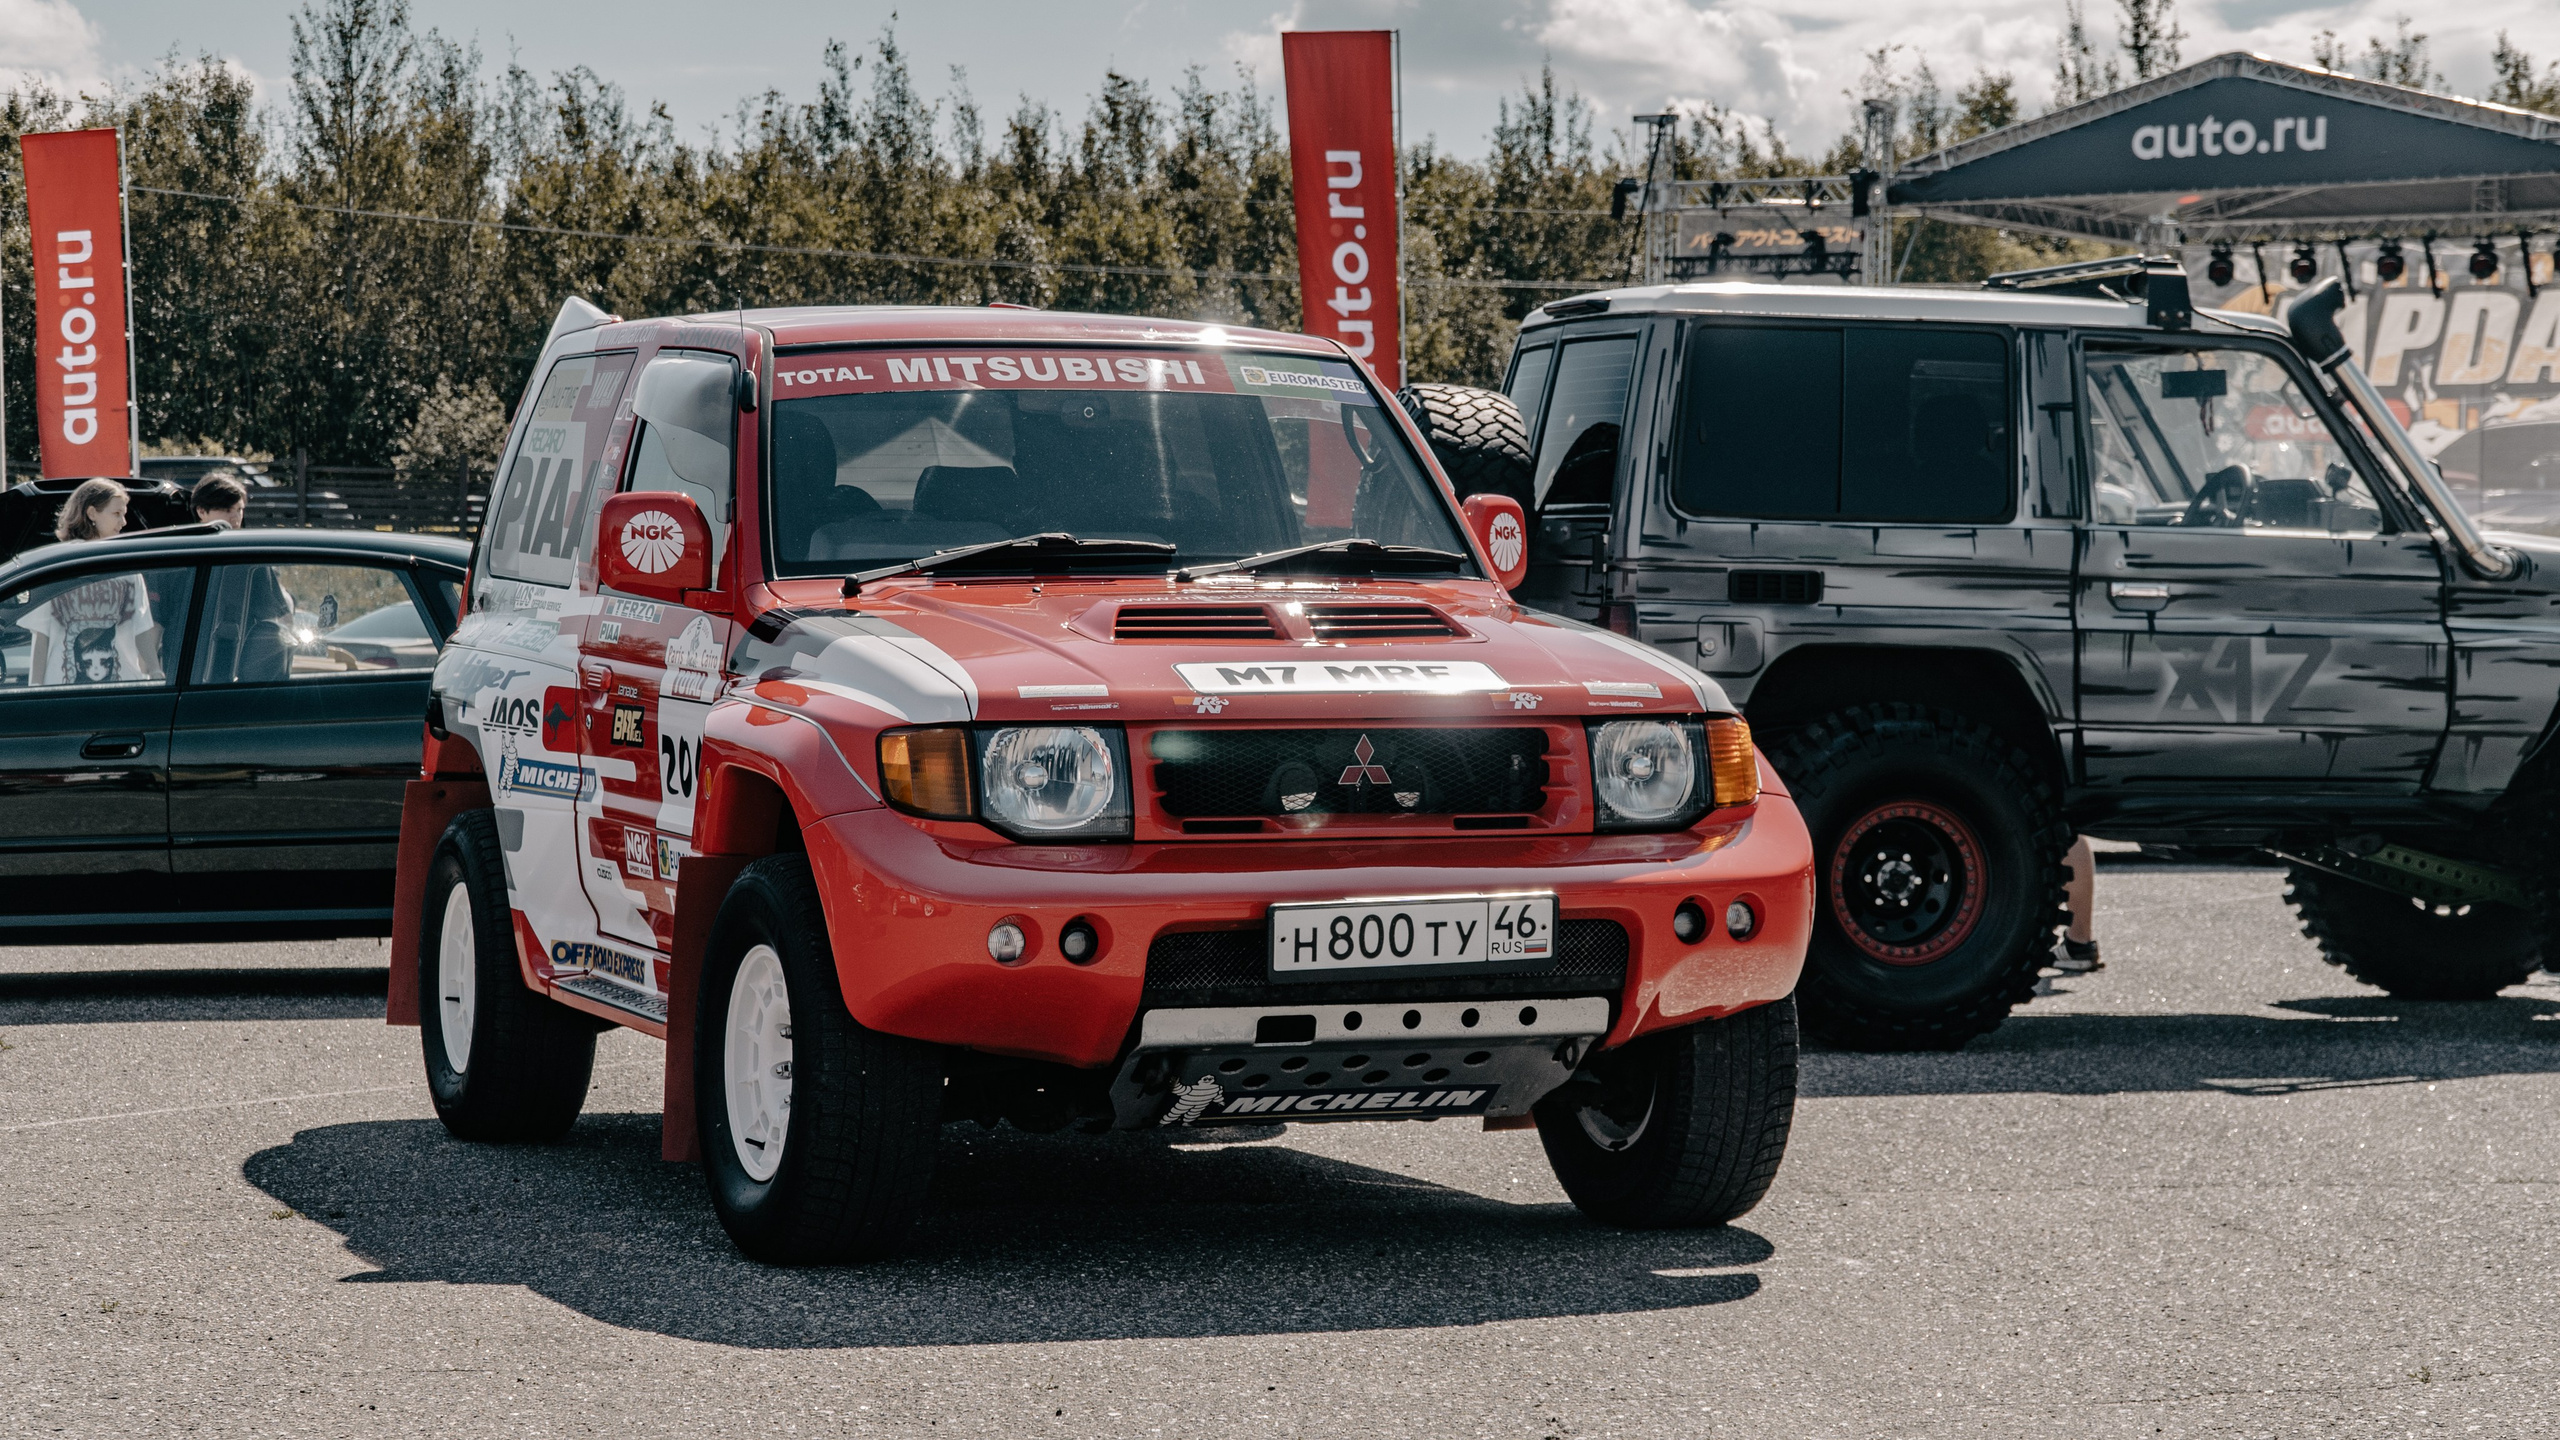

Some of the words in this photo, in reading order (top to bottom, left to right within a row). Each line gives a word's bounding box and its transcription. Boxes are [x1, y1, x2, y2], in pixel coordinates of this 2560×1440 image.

[2131, 115, 2328, 160] auto.ru
[1325, 149, 1376, 373] uto.ru
[56, 230, 98, 445] auto.ru
[777, 366, 874, 386] TOTAL
[885, 356, 1206, 385] MITSUBISHI
[1268, 372, 1364, 391] EUROMASTER
[528, 428, 567, 454] RECARO
[631, 525, 674, 541] NGK
[1494, 526, 1517, 541] NGK
[615, 599, 656, 621] TERZO
[599, 623, 620, 642] PIAA
[1215, 666, 1297, 686] M7
[1192, 696, 1230, 714] K&N
[1509, 693, 1543, 709] K&N
[483, 696, 540, 737] JAOS
[518, 765, 595, 793] MICHELIN
[626, 831, 650, 865] NGK
[1494, 904, 1537, 940] 46
[1491, 940, 1522, 954] RUS
[614, 953, 646, 985] EXPRESS
[1220, 1089, 1488, 1114] MICHELIN
